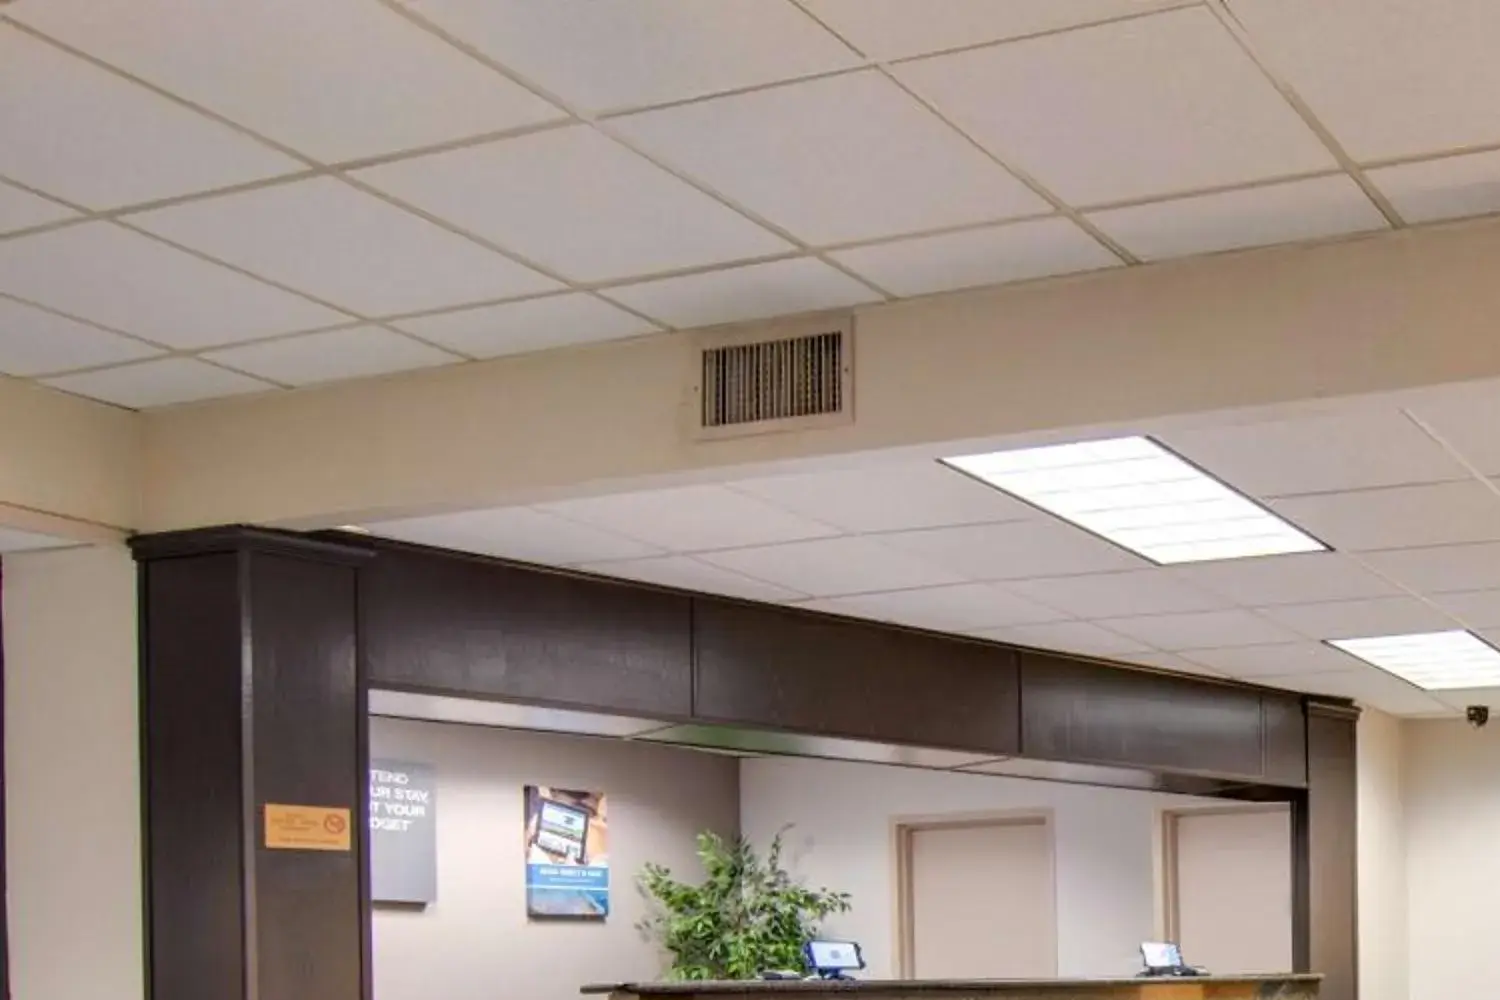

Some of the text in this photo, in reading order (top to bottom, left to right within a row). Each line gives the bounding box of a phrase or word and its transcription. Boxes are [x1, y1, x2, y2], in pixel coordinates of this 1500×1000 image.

[370, 770, 408, 784] TEND
[370, 786, 391, 799] UR
[385, 803, 426, 817] YOUR
[370, 817, 414, 831] DGET
